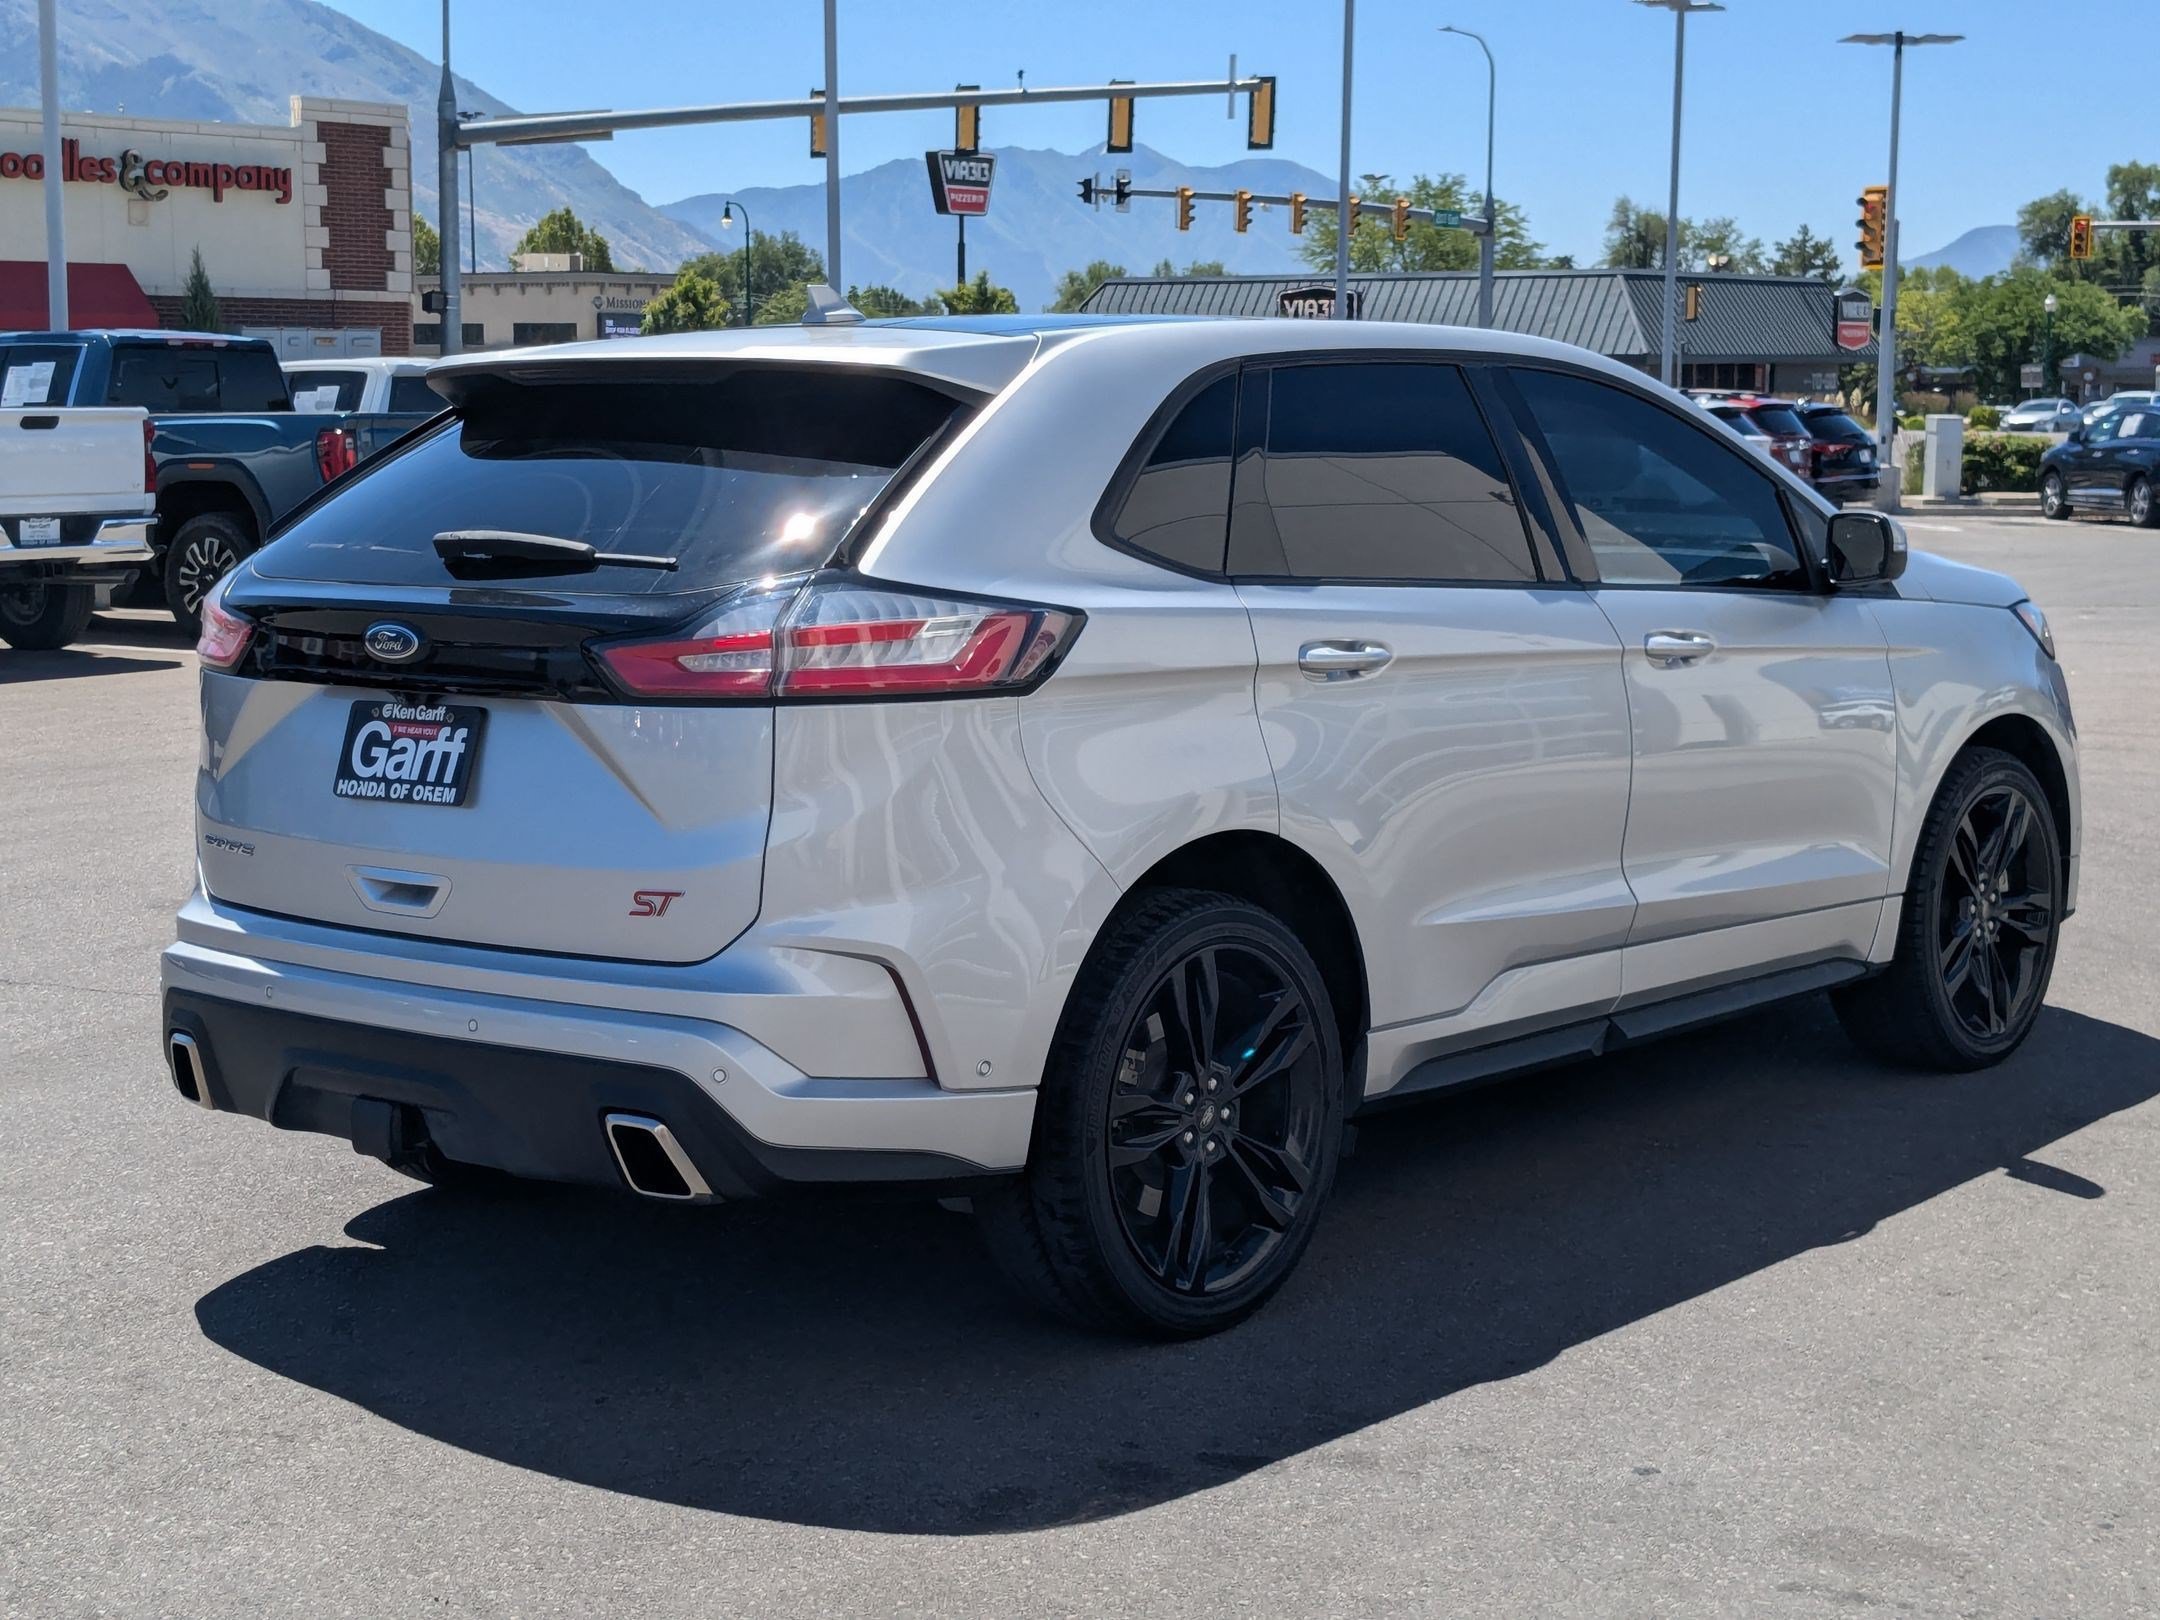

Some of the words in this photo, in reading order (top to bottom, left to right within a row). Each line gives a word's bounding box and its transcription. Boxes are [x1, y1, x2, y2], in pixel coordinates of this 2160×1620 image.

[144, 159, 292, 204] company
[375, 631, 404, 651] Ford
[392, 703, 415, 719] Ken
[416, 705, 447, 722] Garff
[351, 720, 468, 784] Garff
[336, 779, 386, 798] HONDA
[389, 783, 411, 800] OF
[412, 784, 457, 804] OREM
[628, 889, 686, 917] ST
